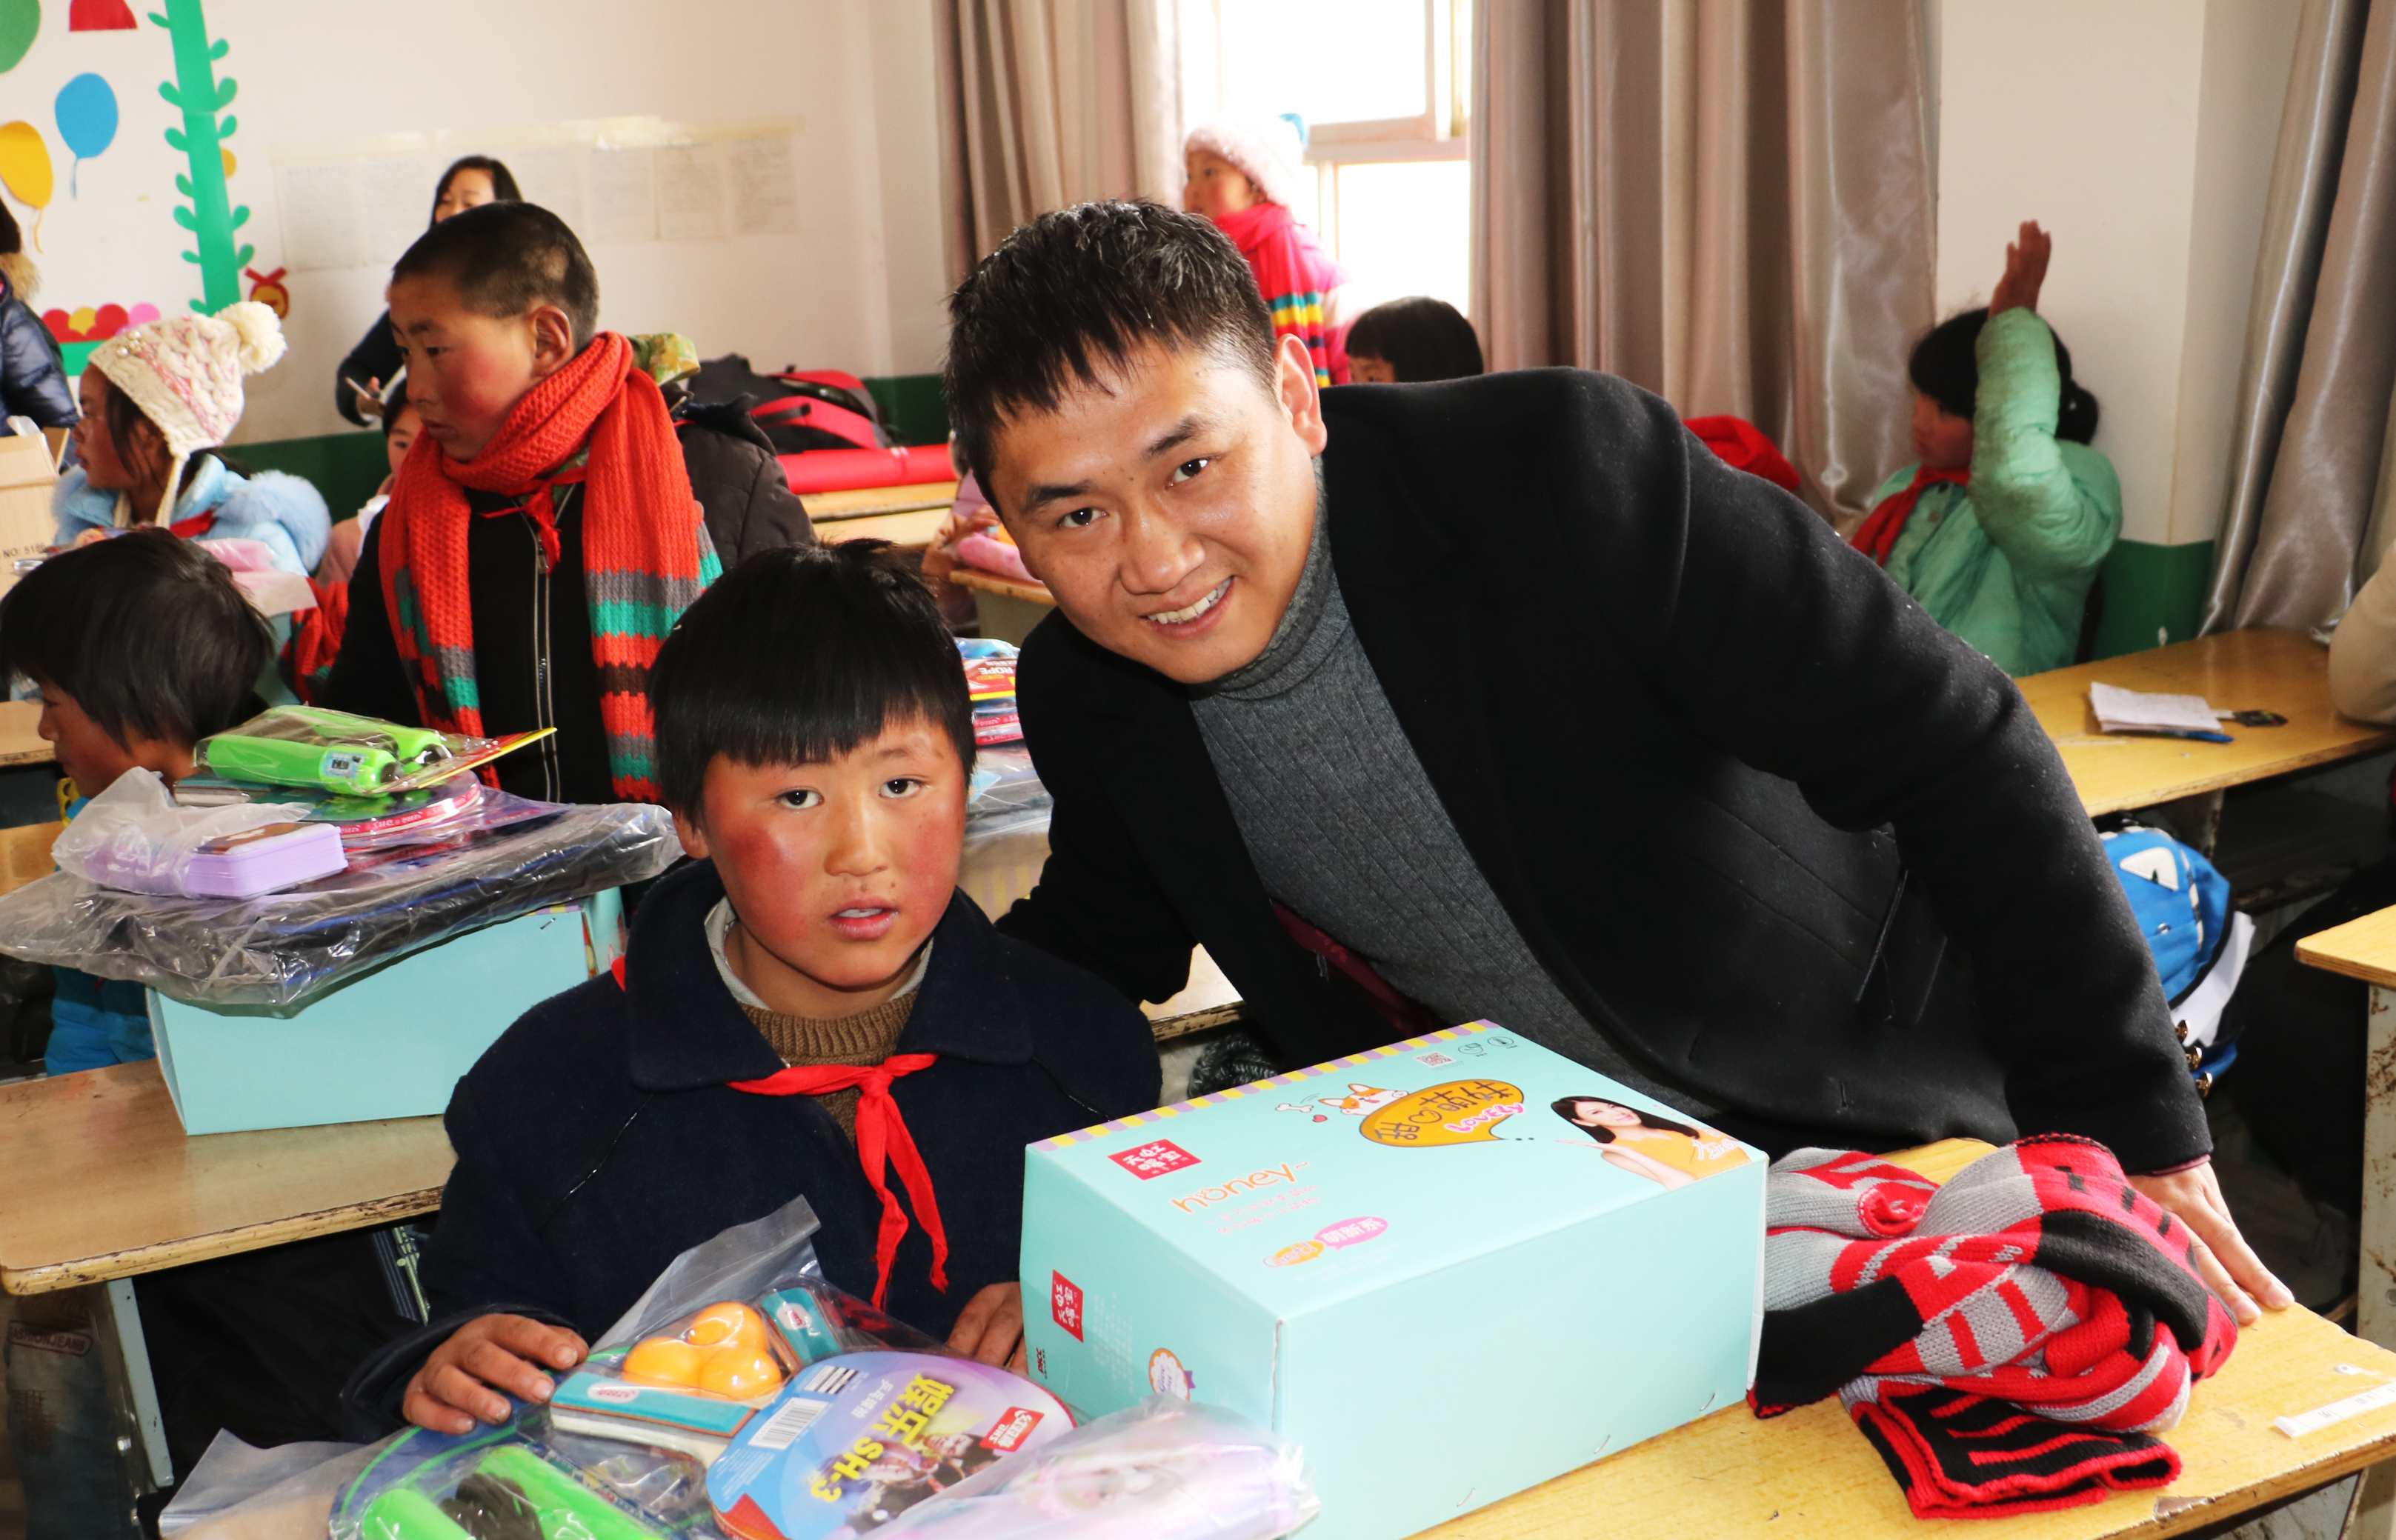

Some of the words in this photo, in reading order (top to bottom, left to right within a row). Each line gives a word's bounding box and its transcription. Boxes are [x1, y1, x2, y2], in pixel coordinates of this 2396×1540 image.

[978, 667, 1014, 675] ROPE
[851, 1379, 893, 1419] 乒乓球拍
[871, 1373, 954, 1445] 娱乐
[811, 1437, 885, 1502] SH-3
